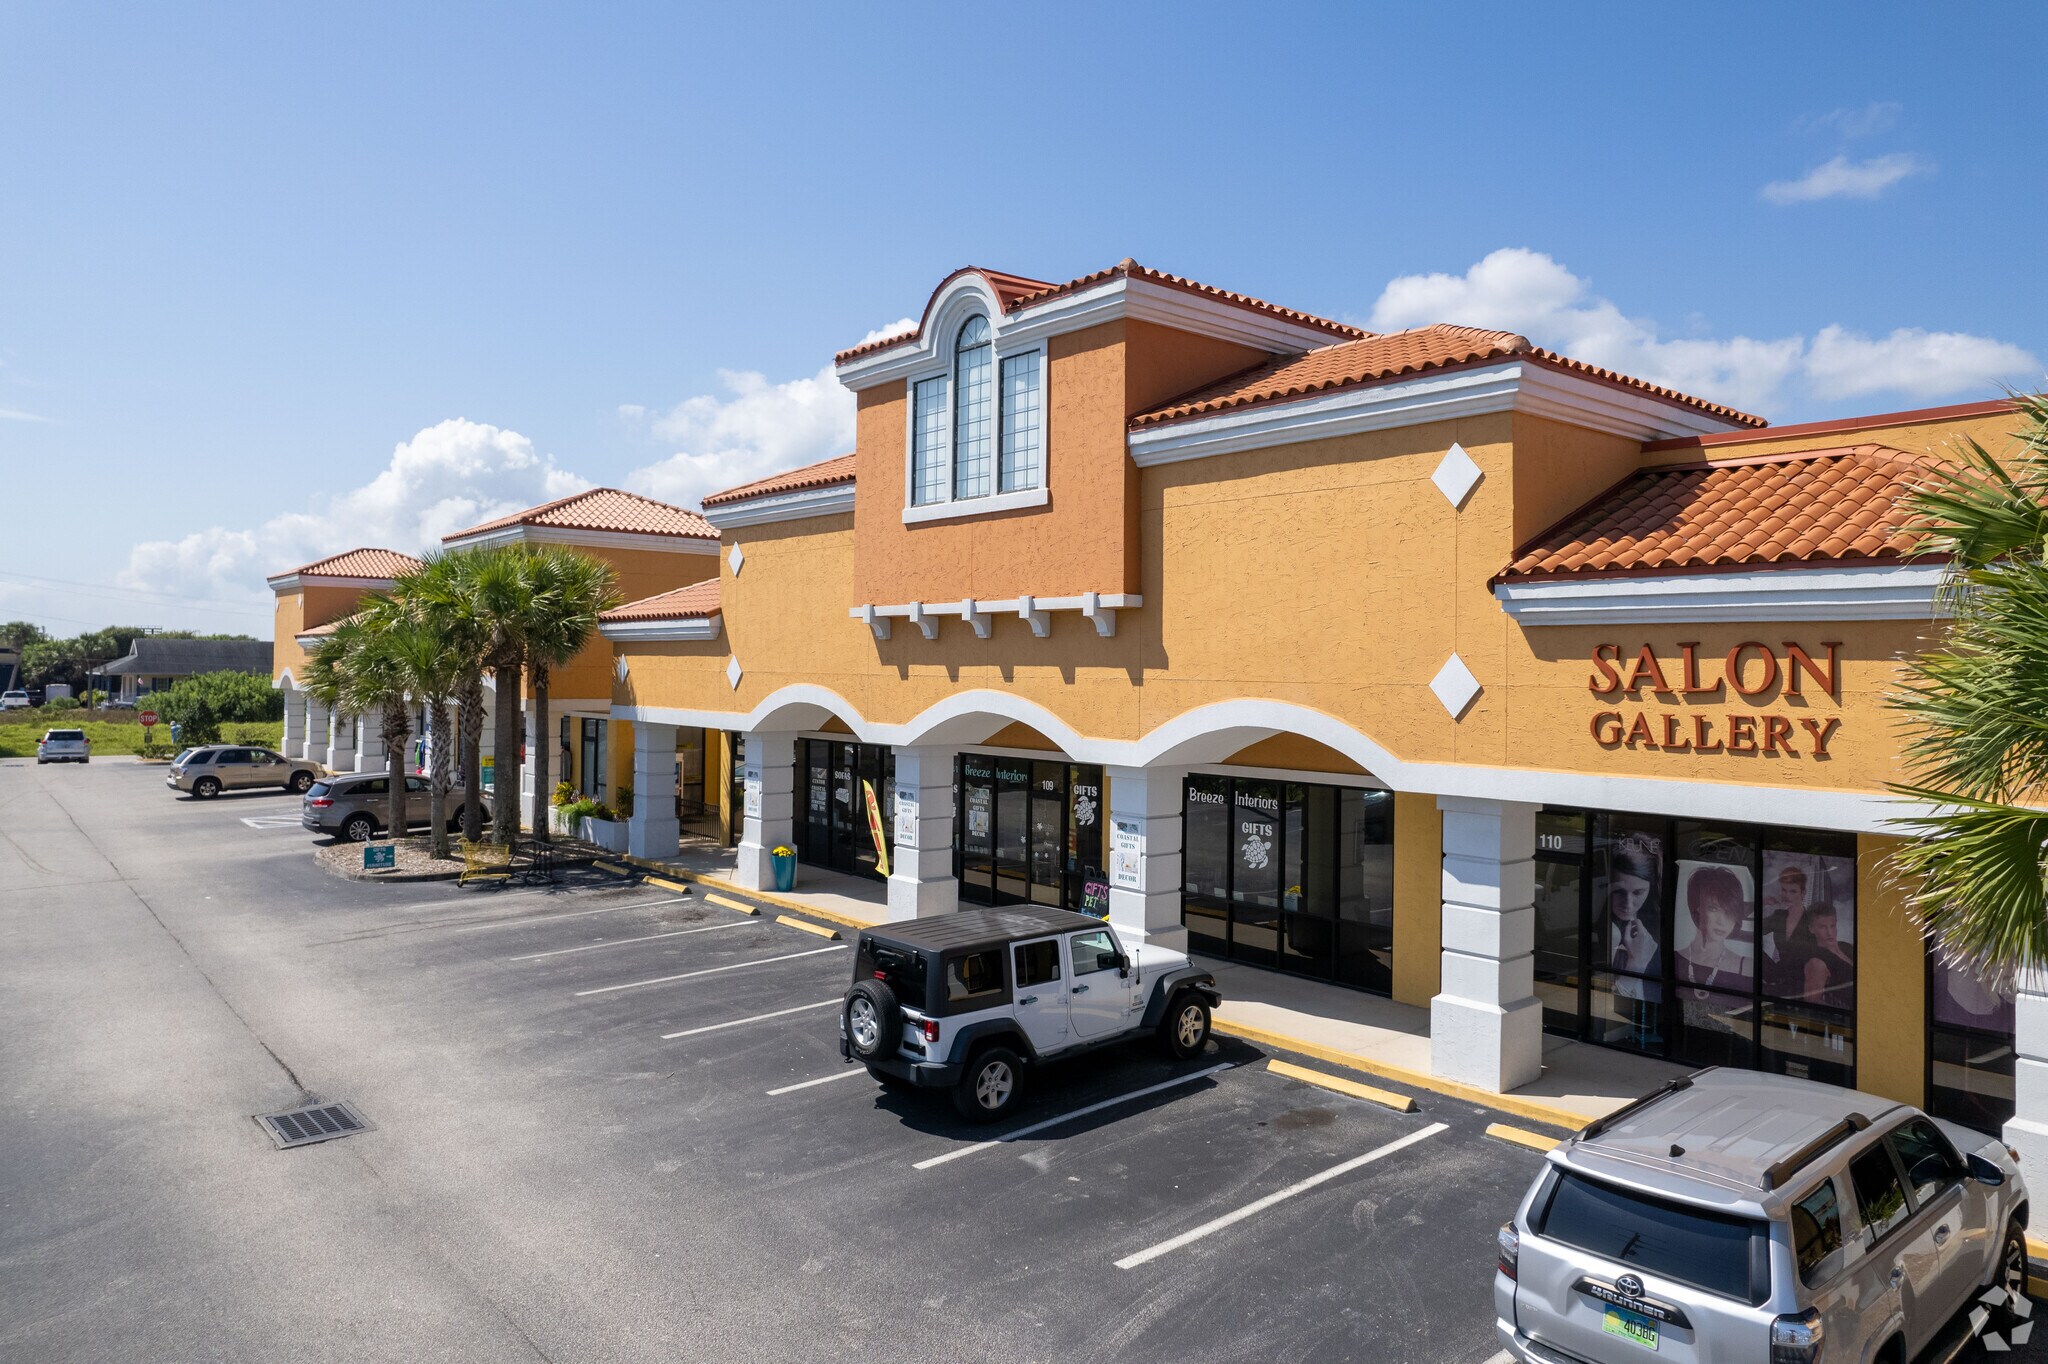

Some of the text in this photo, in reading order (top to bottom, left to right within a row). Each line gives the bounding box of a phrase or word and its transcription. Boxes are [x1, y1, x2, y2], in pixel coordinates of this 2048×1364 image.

[1588, 640, 1845, 697] SALON
[140, 715, 158, 723] STOP
[1589, 710, 1842, 756] GALLERY
[834, 770, 851, 781] SOFAS
[965, 764, 991, 778] Breeze
[1042, 780, 1054, 791] 109
[1073, 785, 1098, 797] GIFTS
[1189, 787, 1278, 810] Breeze Interiors
[1241, 822, 1273, 837] GIFTS
[900, 833, 913, 841] DECOR
[1117, 834, 1139, 842] COASTAL
[1539, 834, 1563, 850] 110
[1121, 842, 1135, 850] GIFTS
[1118, 873, 1137, 882] DECOR
[1084, 882, 1108, 900] GIFTS
[1084, 895, 1098, 909] PET
[1590, 1285, 1665, 1320] 4RUNNER
